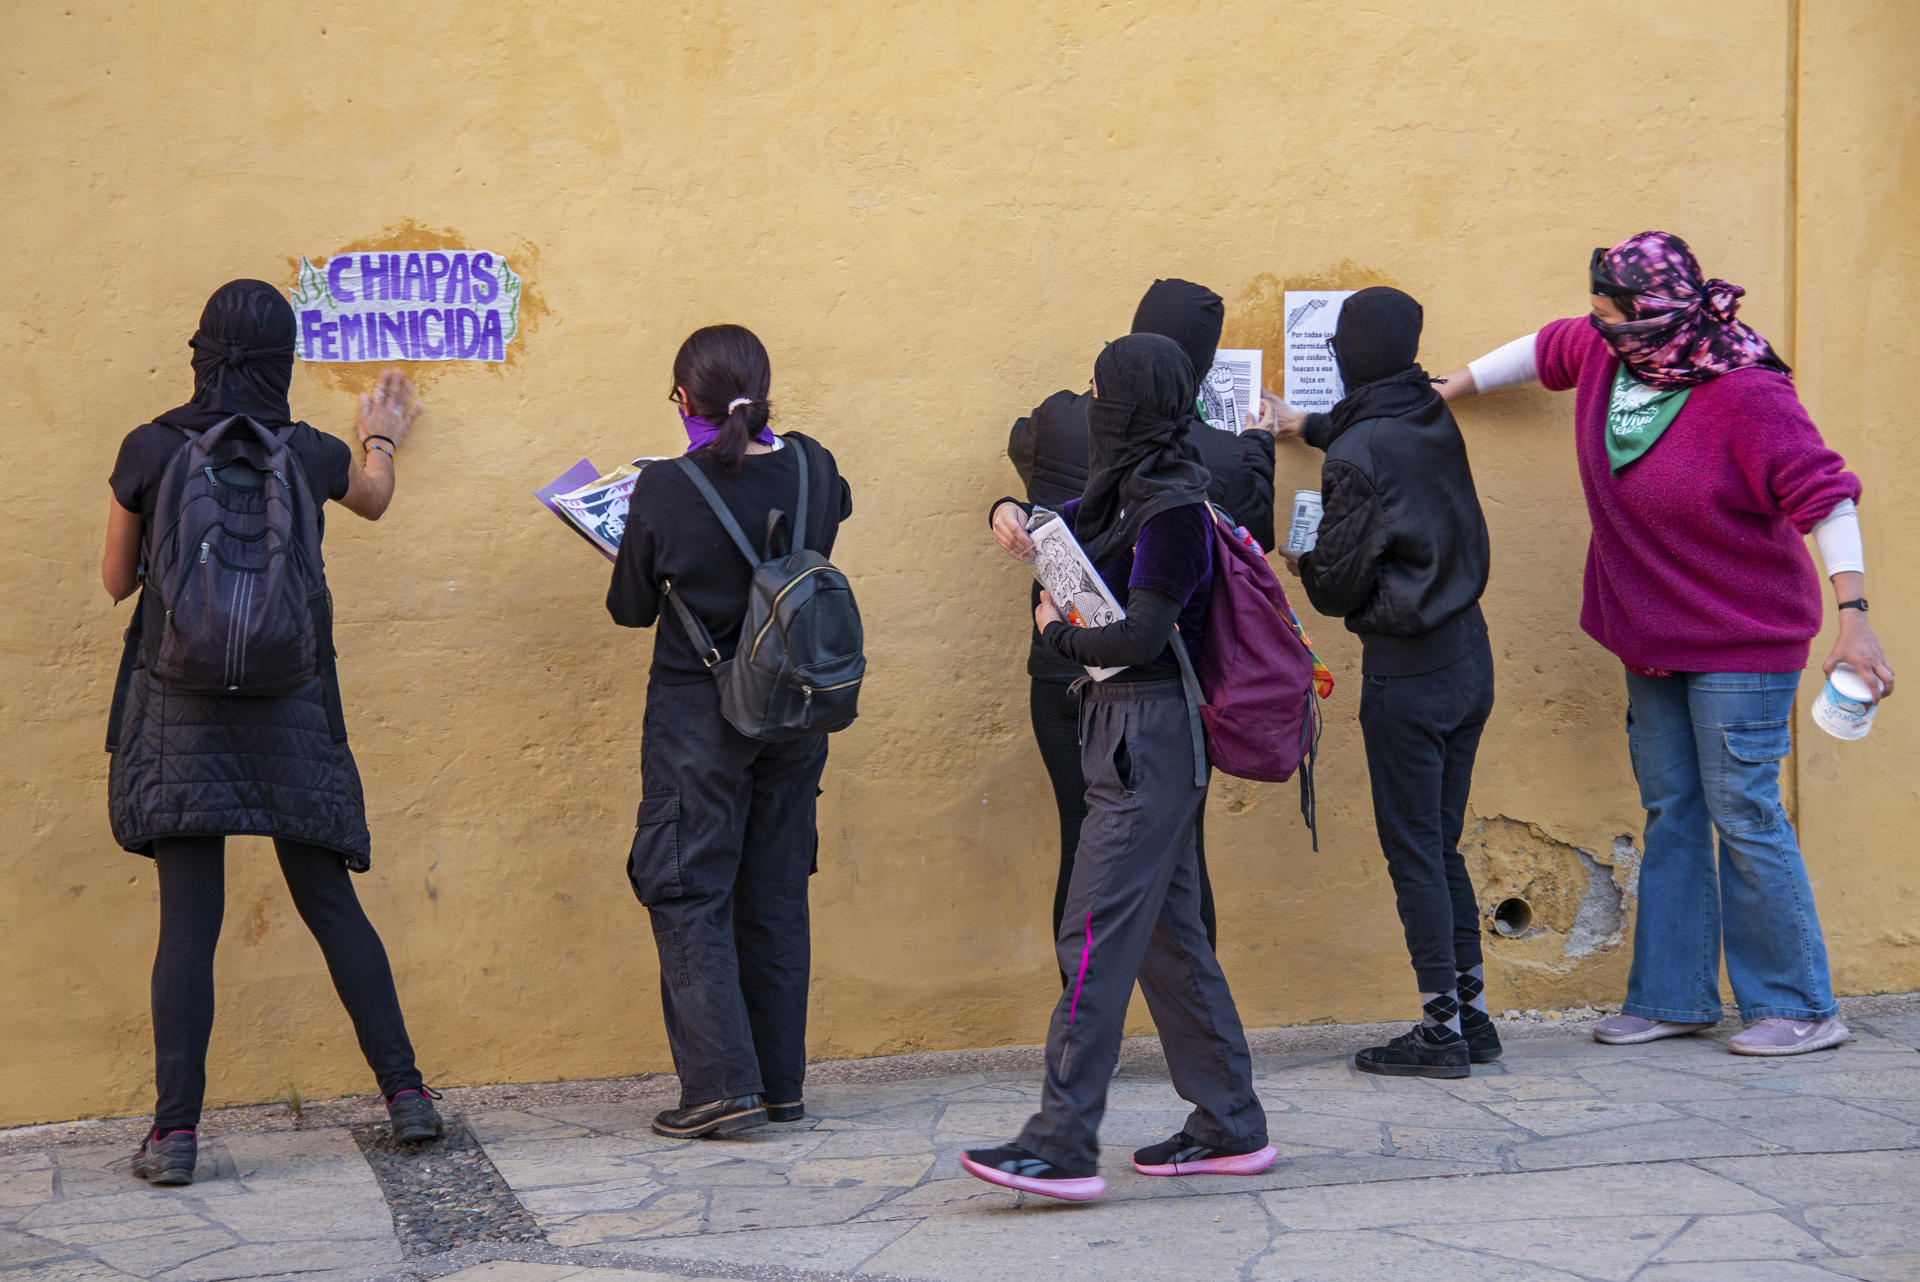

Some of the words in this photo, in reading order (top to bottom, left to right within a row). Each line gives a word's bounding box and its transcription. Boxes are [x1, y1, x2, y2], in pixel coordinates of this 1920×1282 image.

[327, 252, 499, 305] CHIAPAS
[301, 307, 504, 361] FEMINICIDA
[1293, 354, 1305, 362] que
[1305, 353, 1327, 361] cuidan
